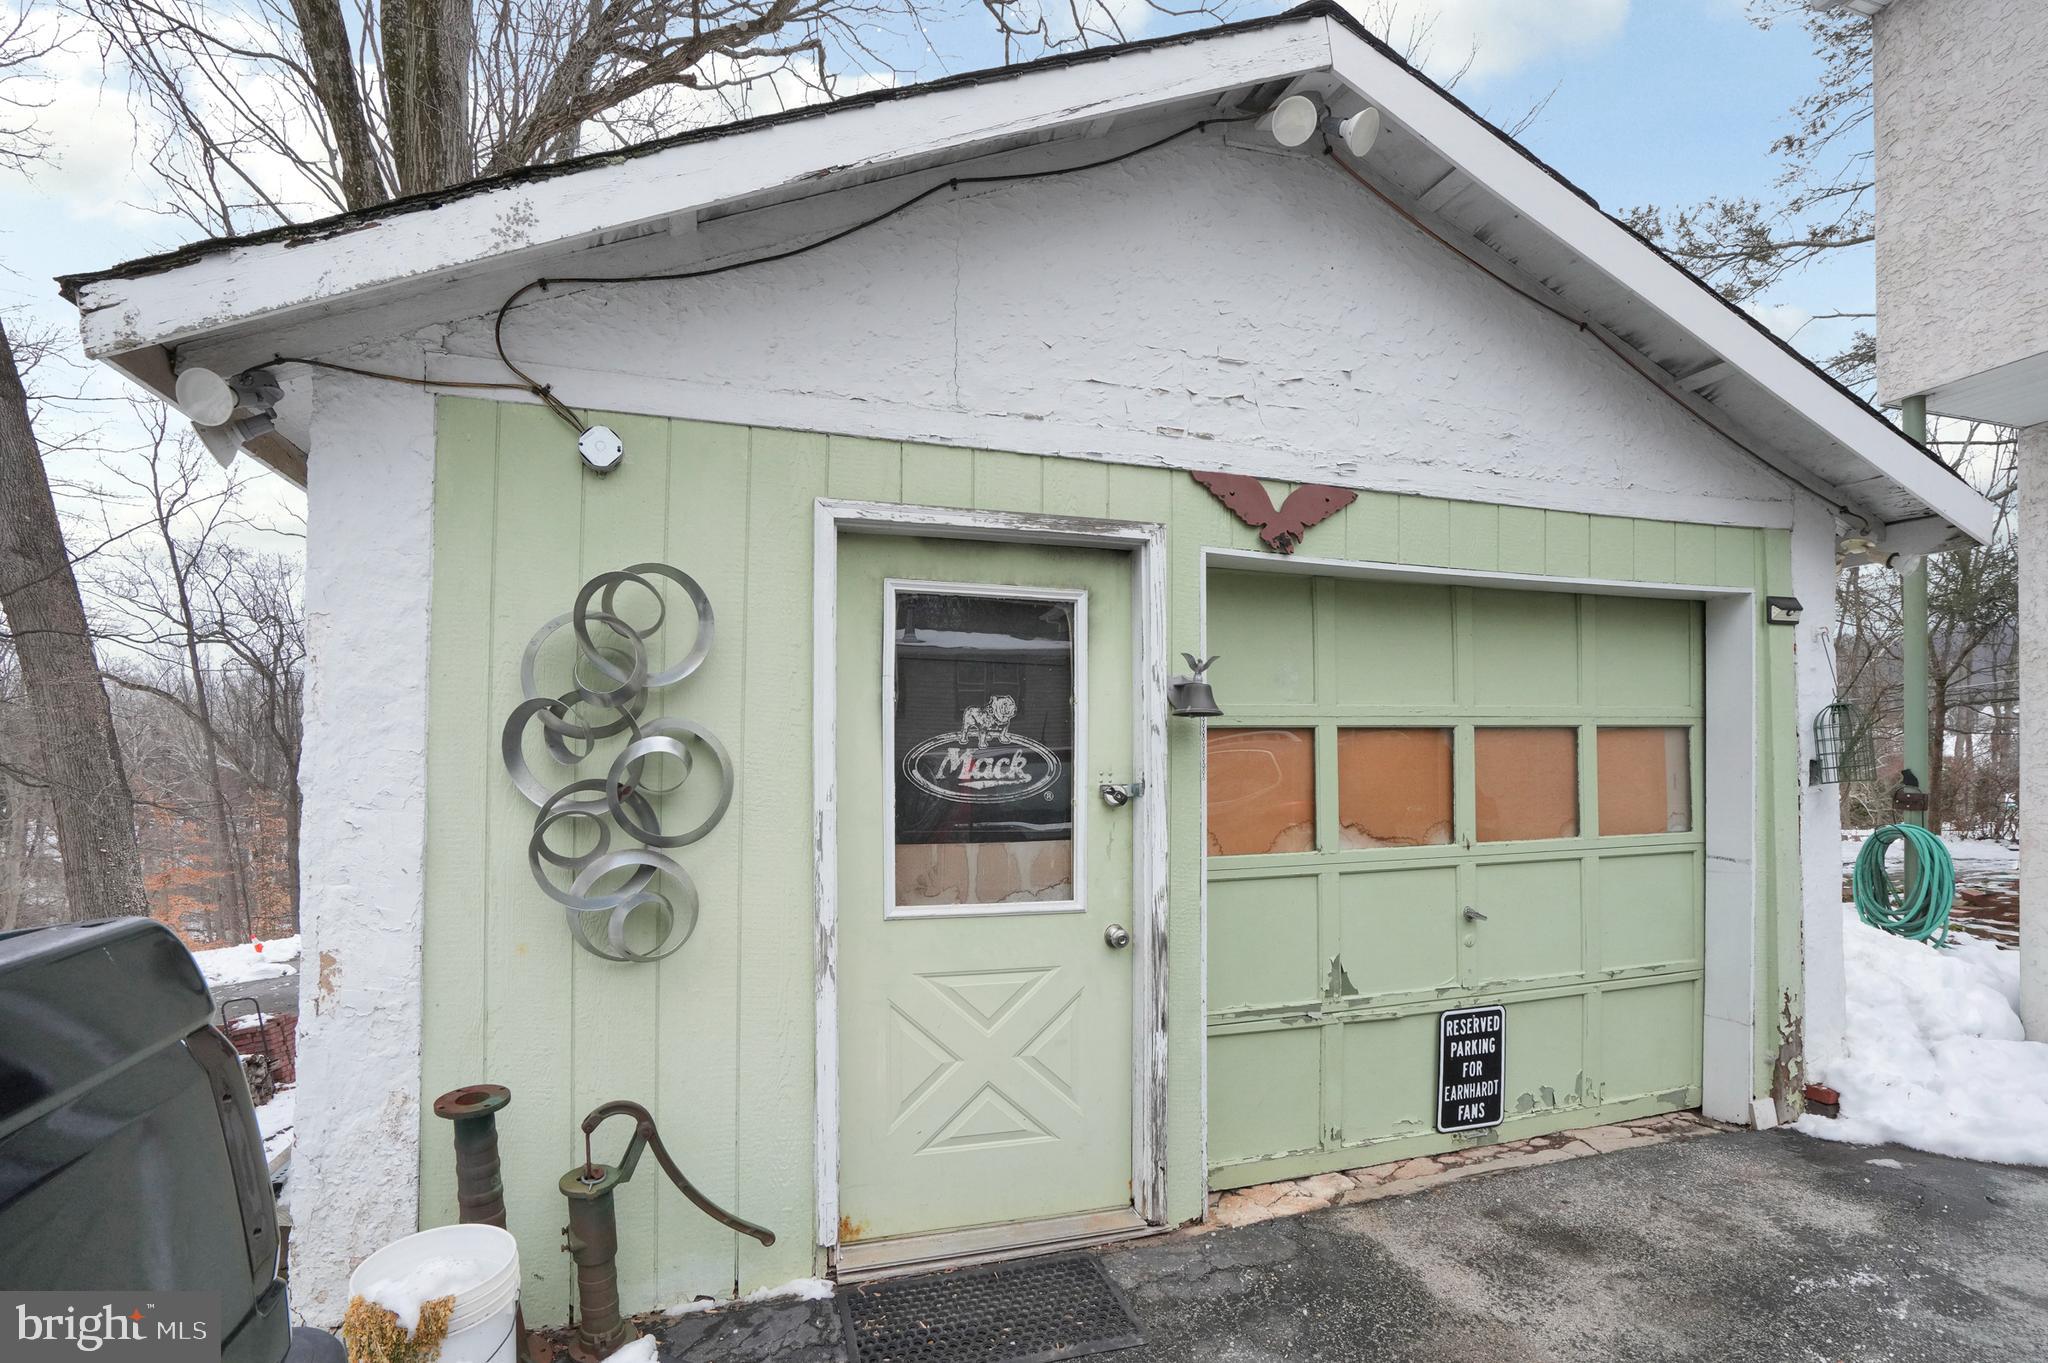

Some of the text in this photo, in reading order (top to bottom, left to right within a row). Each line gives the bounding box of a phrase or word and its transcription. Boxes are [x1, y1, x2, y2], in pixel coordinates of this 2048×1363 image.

[936, 748, 1032, 789] Mack
[1446, 1015, 1500, 1037] RESERVED
[1450, 1037, 1496, 1058] PARKING
[1462, 1060, 1483, 1078] FOR
[1444, 1080, 1499, 1102] EARNHARDT
[1458, 1102, 1485, 1121] FANS
